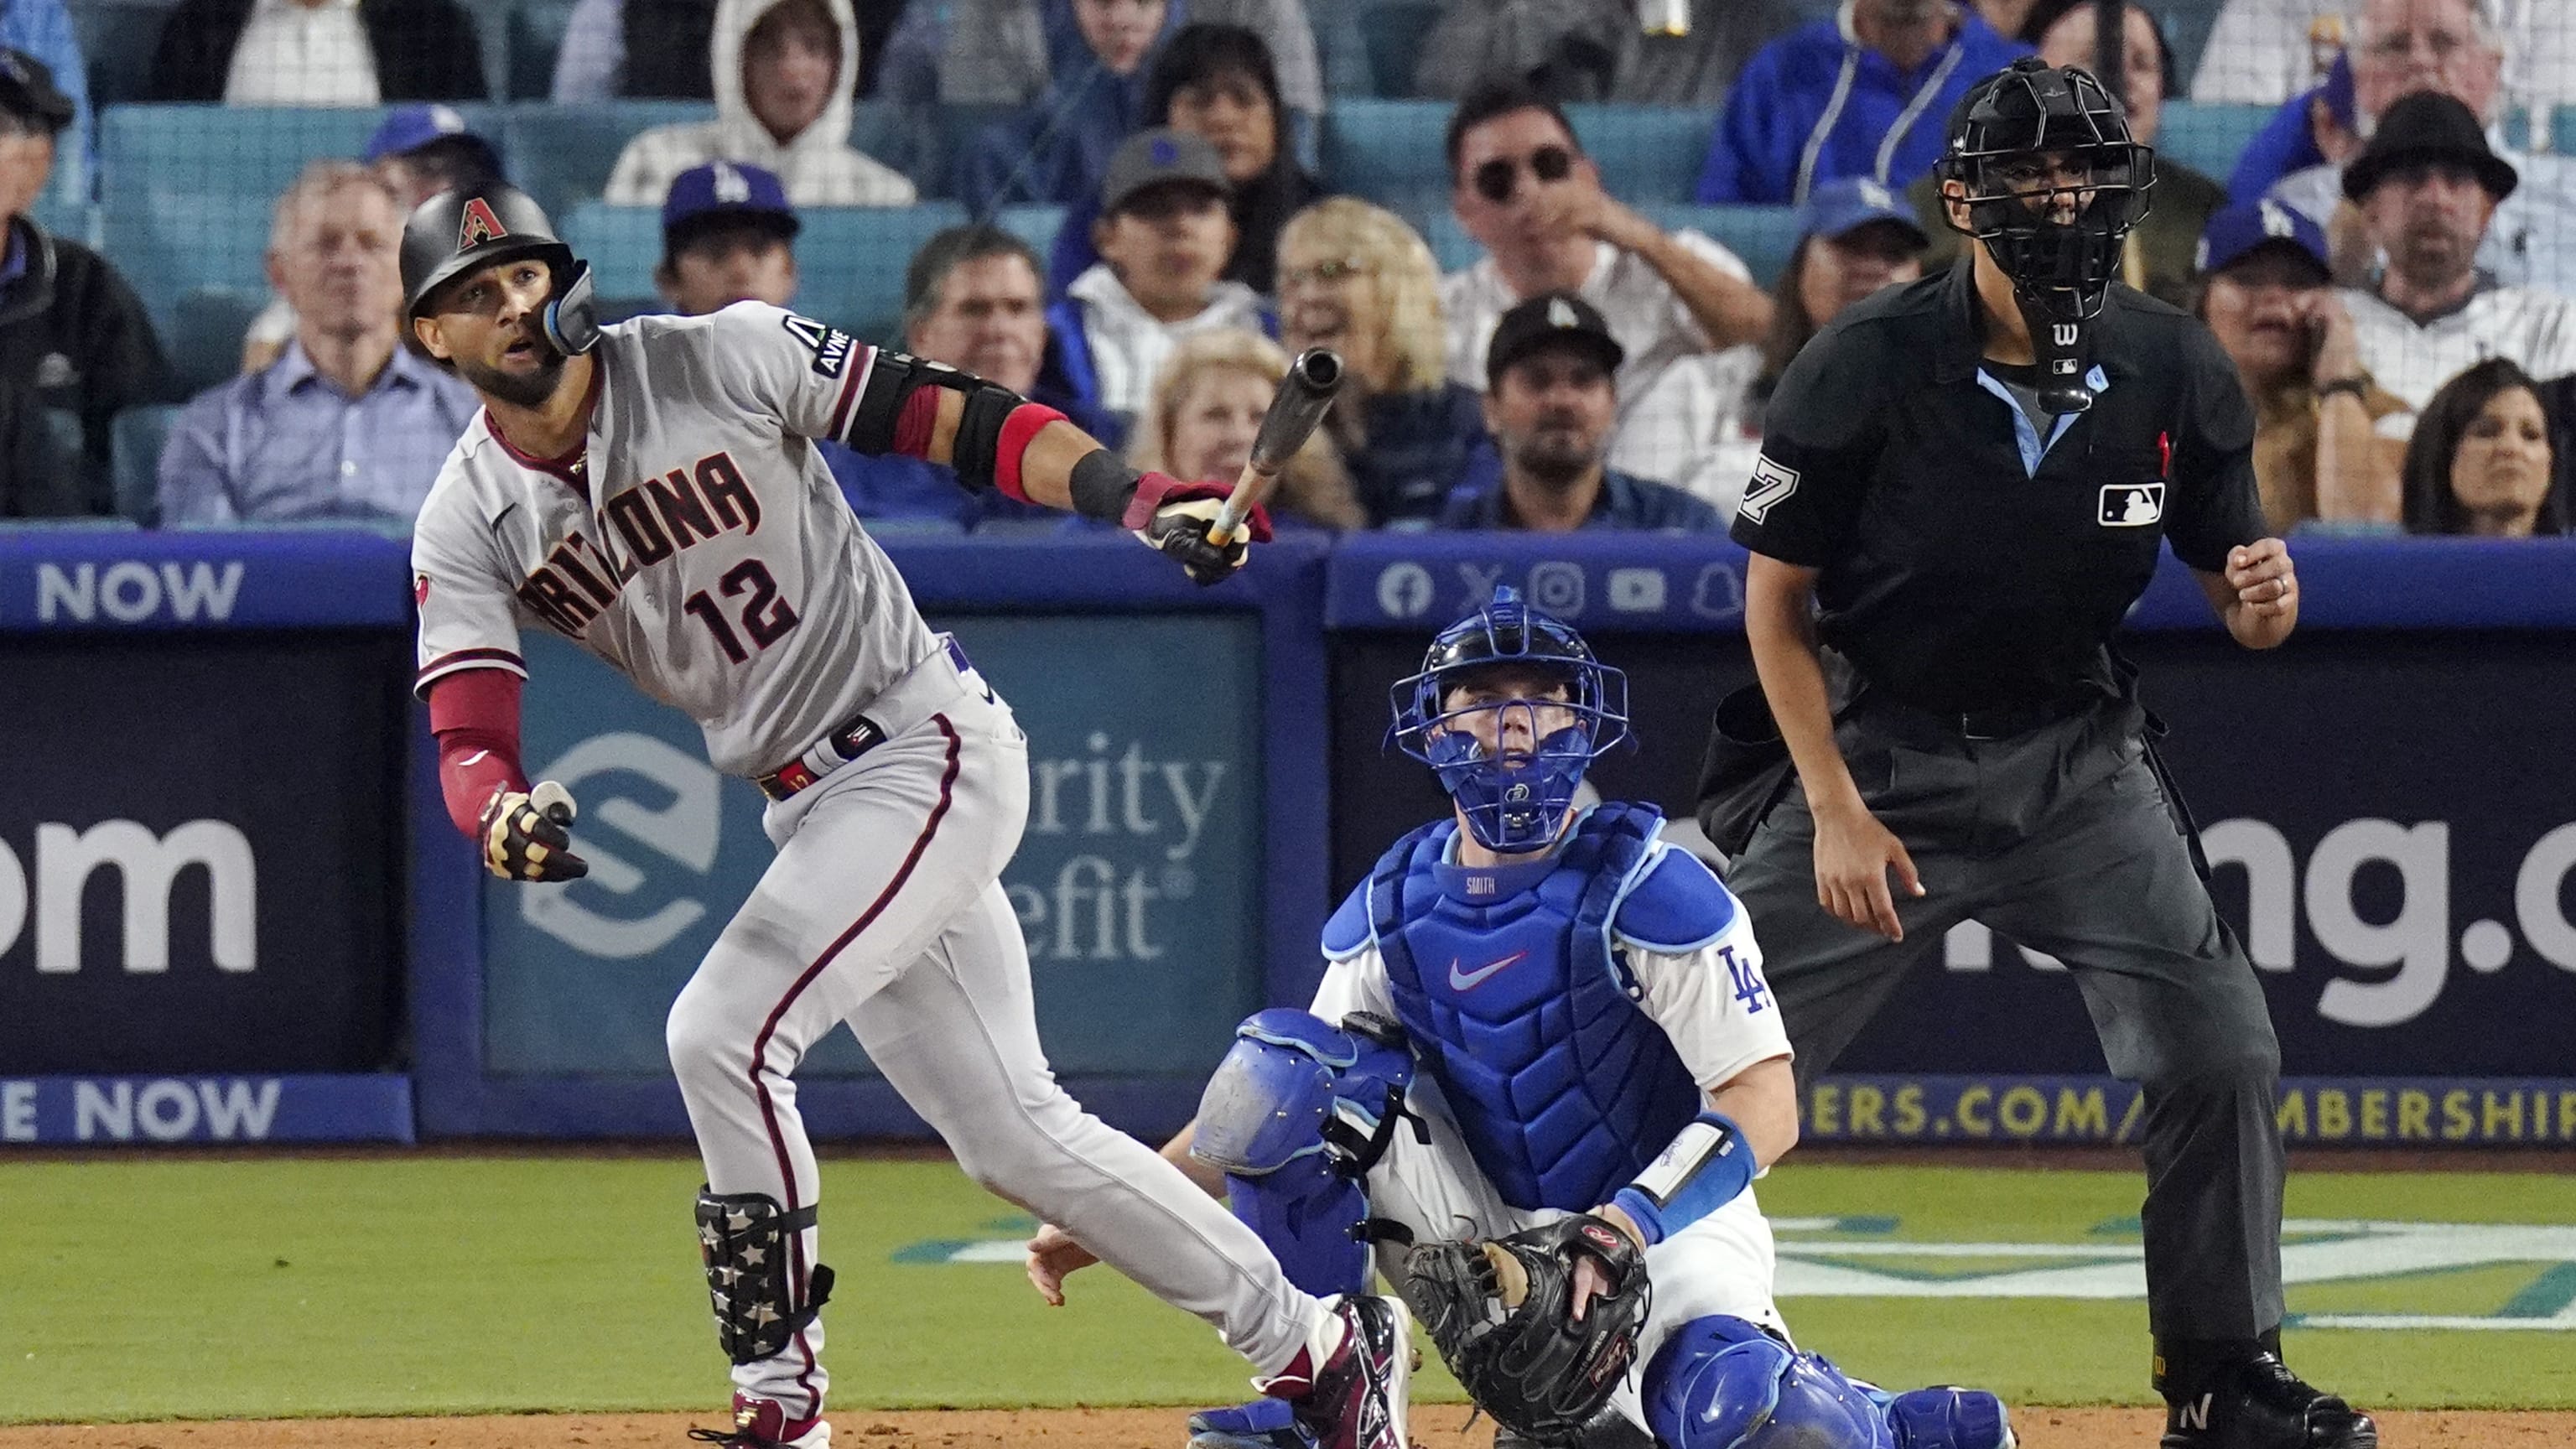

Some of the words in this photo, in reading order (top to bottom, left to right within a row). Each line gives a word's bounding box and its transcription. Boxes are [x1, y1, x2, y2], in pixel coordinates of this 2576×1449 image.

[455, 196, 508, 255] A
[820, 329, 849, 373] AVNE
[1737, 452, 1800, 526] 7
[516, 450, 761, 641] ARIZONA
[36, 559, 245, 622] NOW
[683, 558, 800, 666] 12
[1031, 730, 1227, 860] rity
[0, 818, 257, 974] m
[1466, 876, 1495, 896] SMITH
[1717, 945, 1772, 1014] LA
[2, 1080, 38, 1143] E
[74, 1078, 282, 1143] NOW
[1800, 1085, 2144, 1139] ERS.COM/
[2276, 1088, 2576, 1139] MBERSHIP
[2180, 1392, 2214, 1430] N
